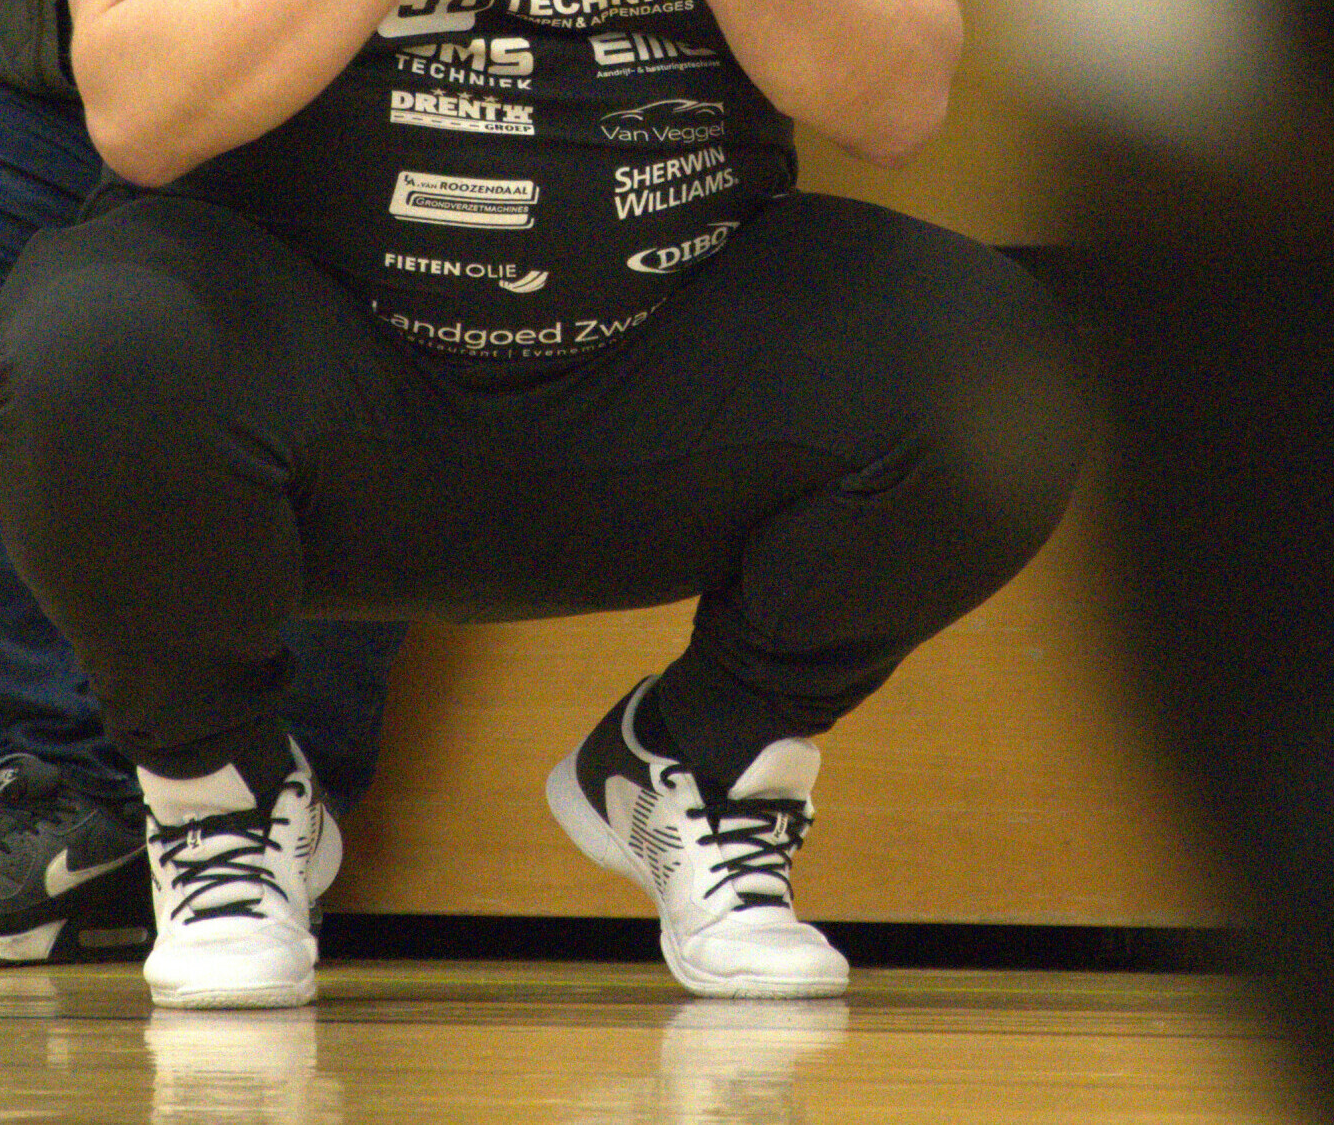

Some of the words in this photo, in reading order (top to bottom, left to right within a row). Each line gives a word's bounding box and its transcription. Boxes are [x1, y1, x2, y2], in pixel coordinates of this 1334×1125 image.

[576, 16, 587, 29] &
[591, 0, 695, 26] APPENDAGES
[395, 53, 533, 91] TECHNIEK
[484, 124, 532, 133] GROEP
[601, 125, 649, 142] Van
[614, 146, 726, 193] SHERWIN
[439, 181, 529, 195] ROOZENDAAL
[416, 197, 529, 214] GRONDVERZETMACHINES
[657, 227, 728, 269] DIBO
[384, 253, 462, 277] FIETEN
[465, 263, 517, 278] OLIE
